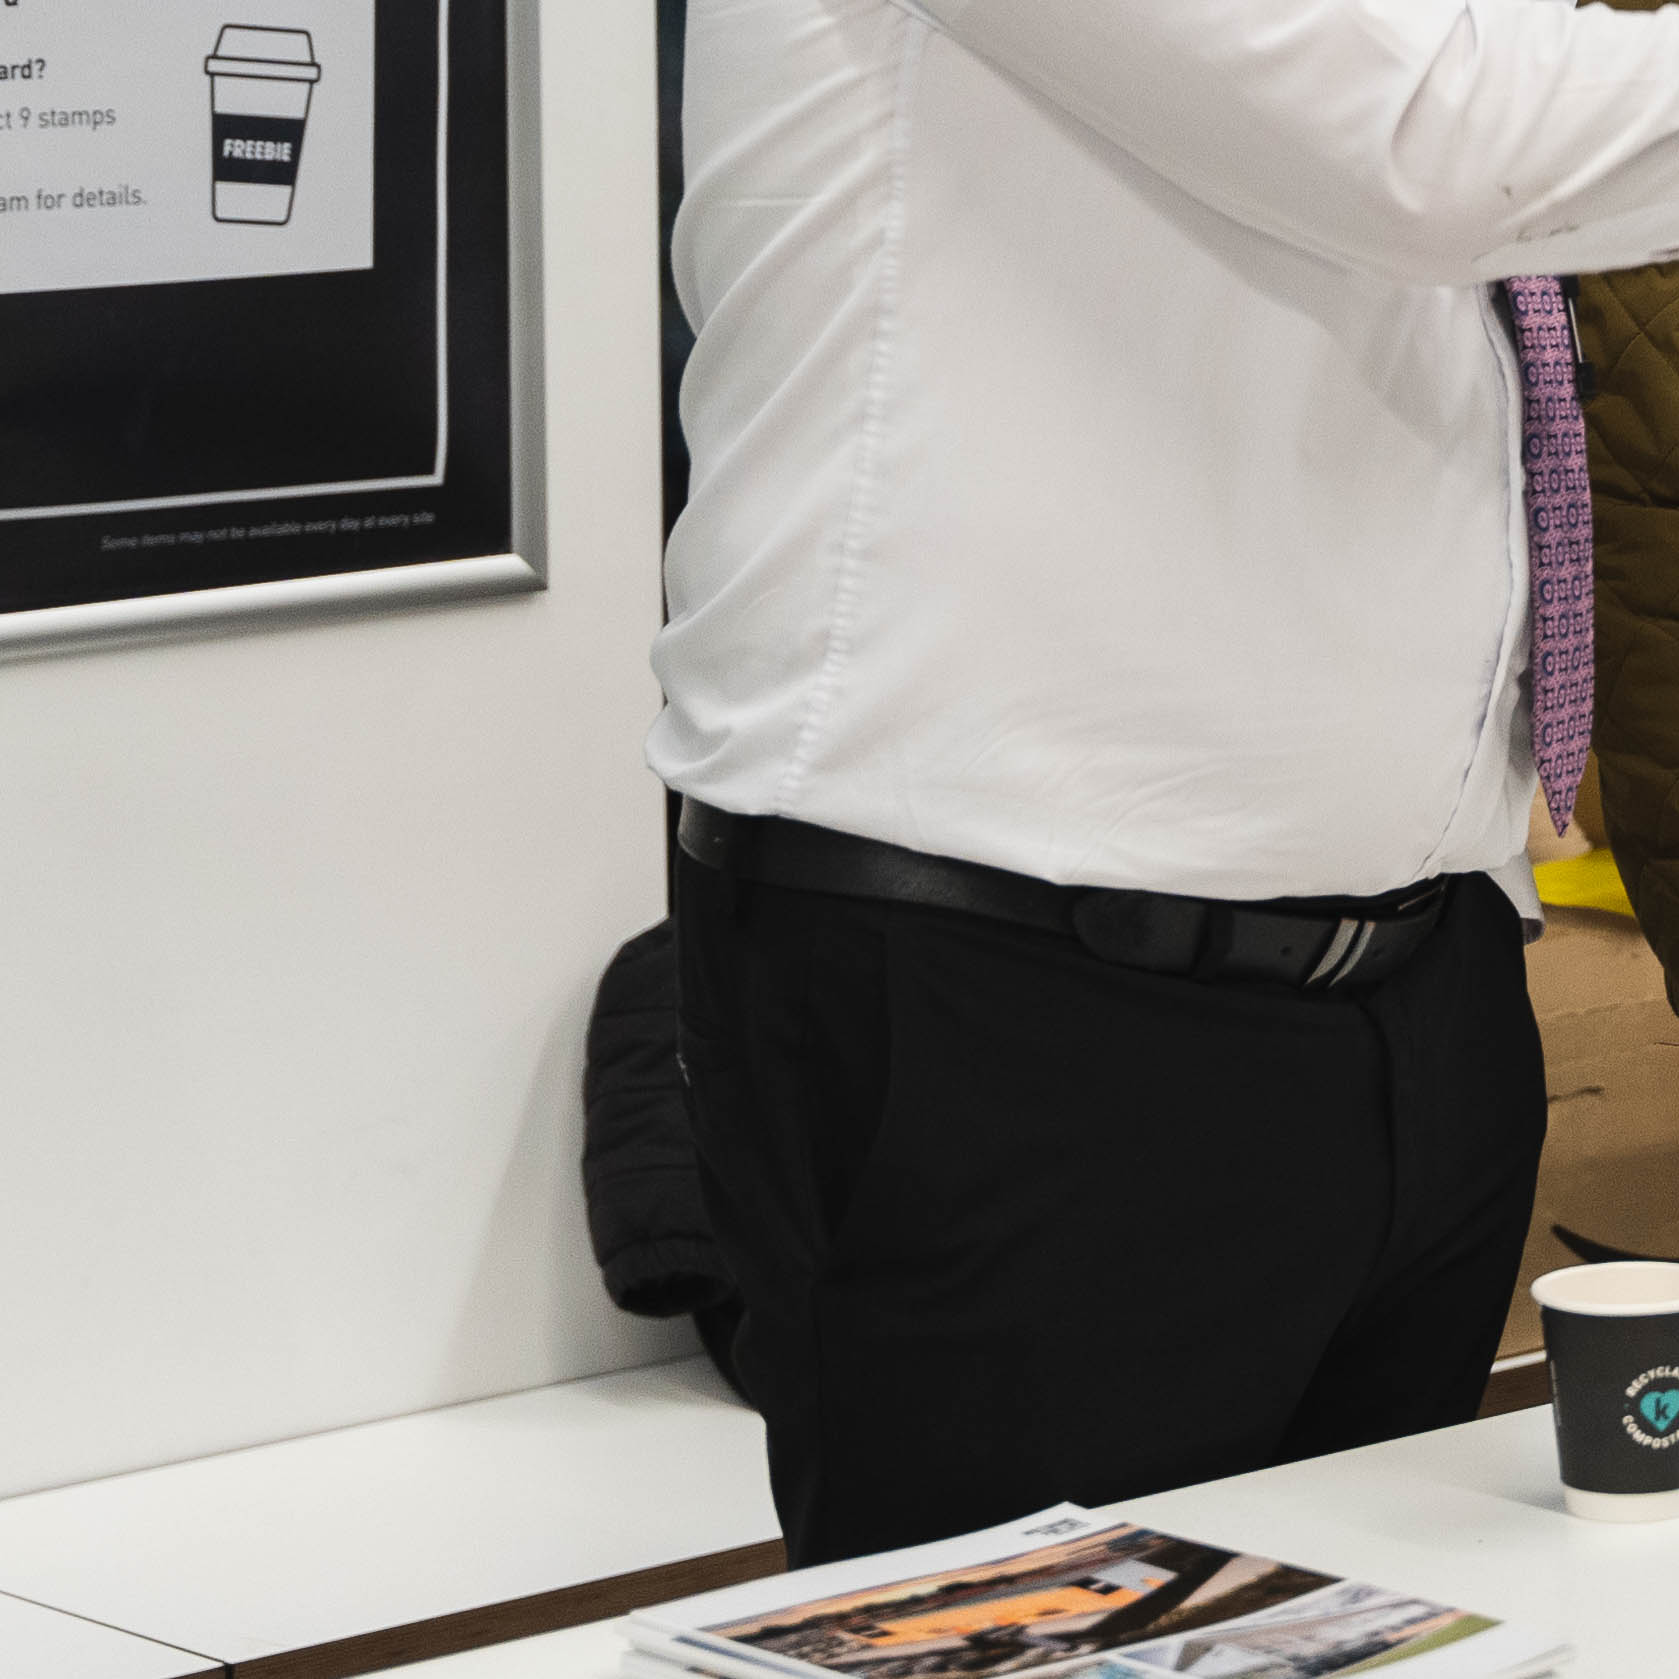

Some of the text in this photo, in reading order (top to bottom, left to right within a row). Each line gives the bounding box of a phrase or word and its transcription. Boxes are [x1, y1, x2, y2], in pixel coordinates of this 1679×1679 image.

[18, 106, 31, 128] 9
[38, 107, 117, 132] stamps
[222, 138, 292, 162] FREEBIE
[36, 188, 66, 210] for
[72, 184, 147, 208] details.
[102, 534, 137, 551] Some
[207, 526, 228, 539] not
[304, 520, 337, 535] every
[378, 514, 410, 528] every
